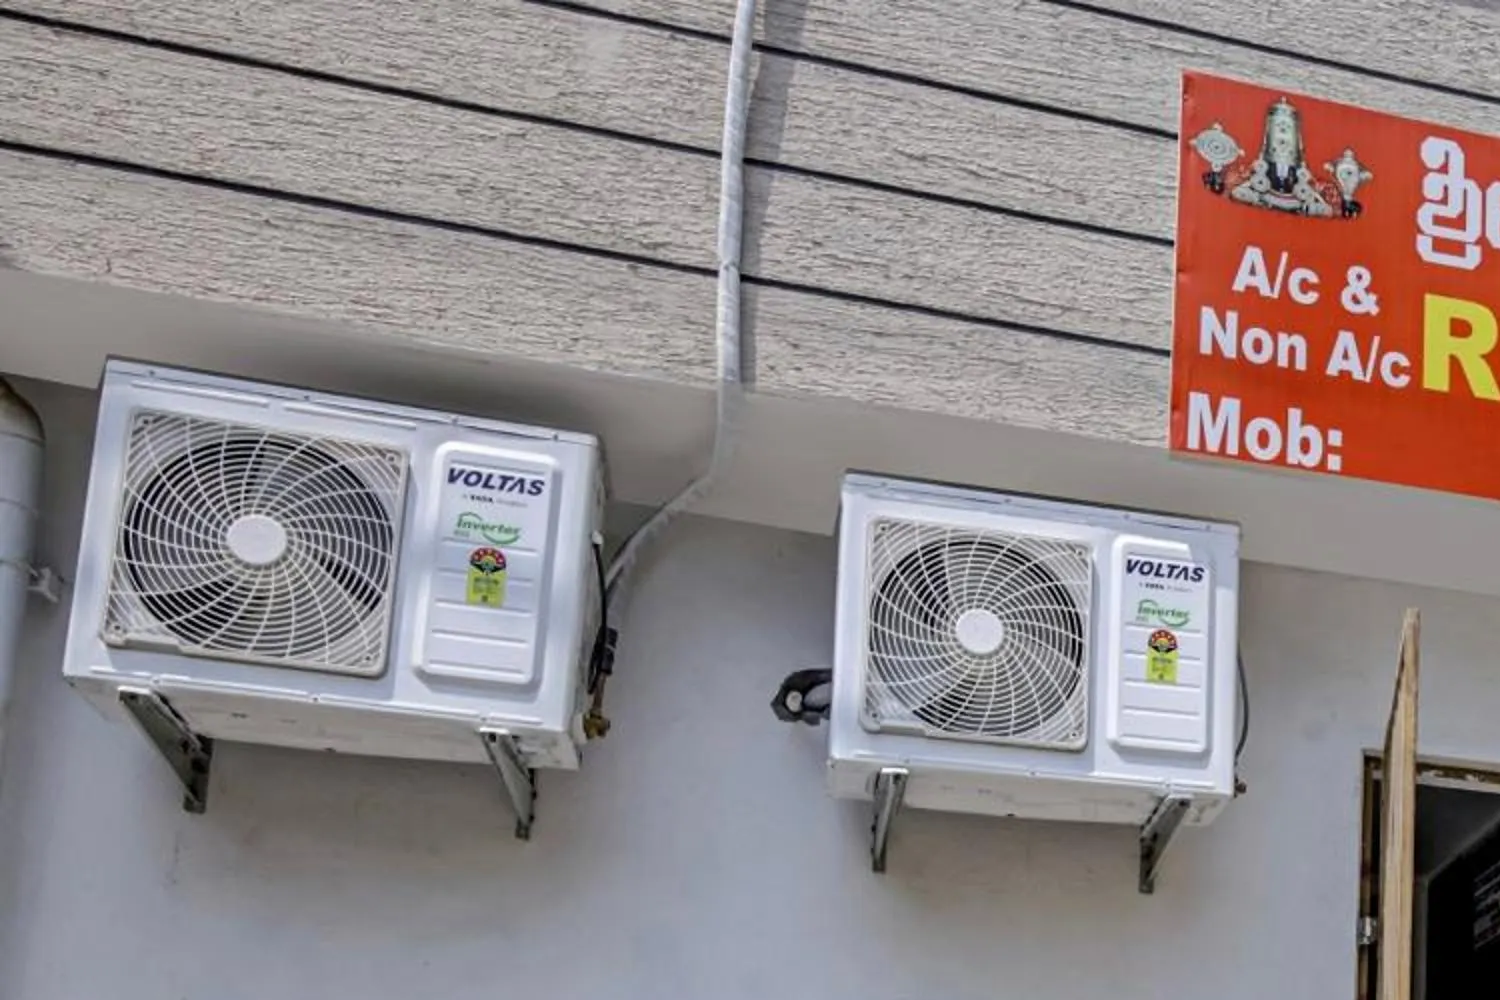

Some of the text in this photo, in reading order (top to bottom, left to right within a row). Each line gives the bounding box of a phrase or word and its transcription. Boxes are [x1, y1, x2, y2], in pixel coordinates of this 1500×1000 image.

[1230, 245, 1380, 316] A/c &
[1198, 304, 1412, 388] Non A/c
[1185, 390, 1344, 472] Mob:
[446, 467, 546, 497] VOLTAS
[1125, 558, 1206, 583] VOLTAS
